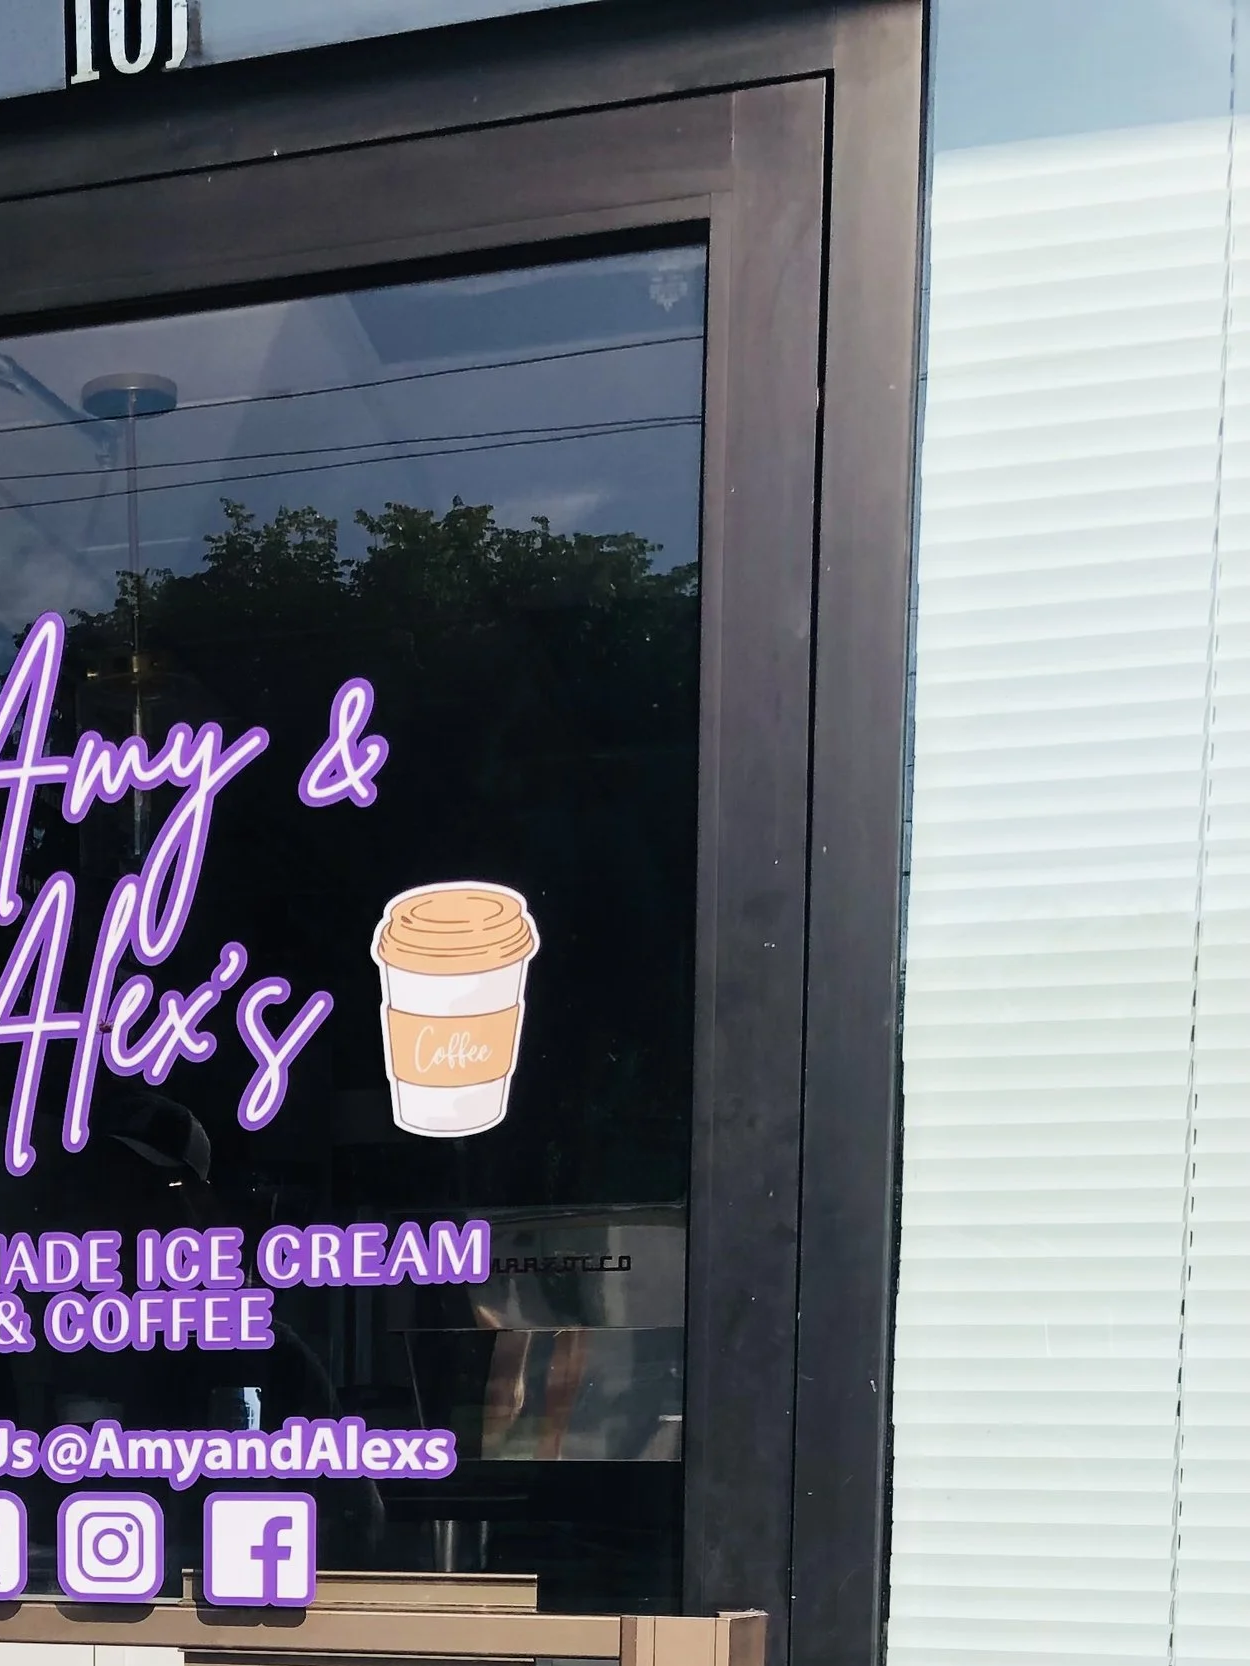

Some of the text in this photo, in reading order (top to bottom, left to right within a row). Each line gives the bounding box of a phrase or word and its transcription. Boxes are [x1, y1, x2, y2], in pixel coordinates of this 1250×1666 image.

[304, 684, 382, 801] &
[414, 1025, 492, 1074] Coffee
[144, 1235, 236, 1283] ICE
[264, 1228, 484, 1281] CREAM
[51, 1296, 268, 1345] COFFEE
[47, 1424, 450, 1483] @AmyandAlexs
